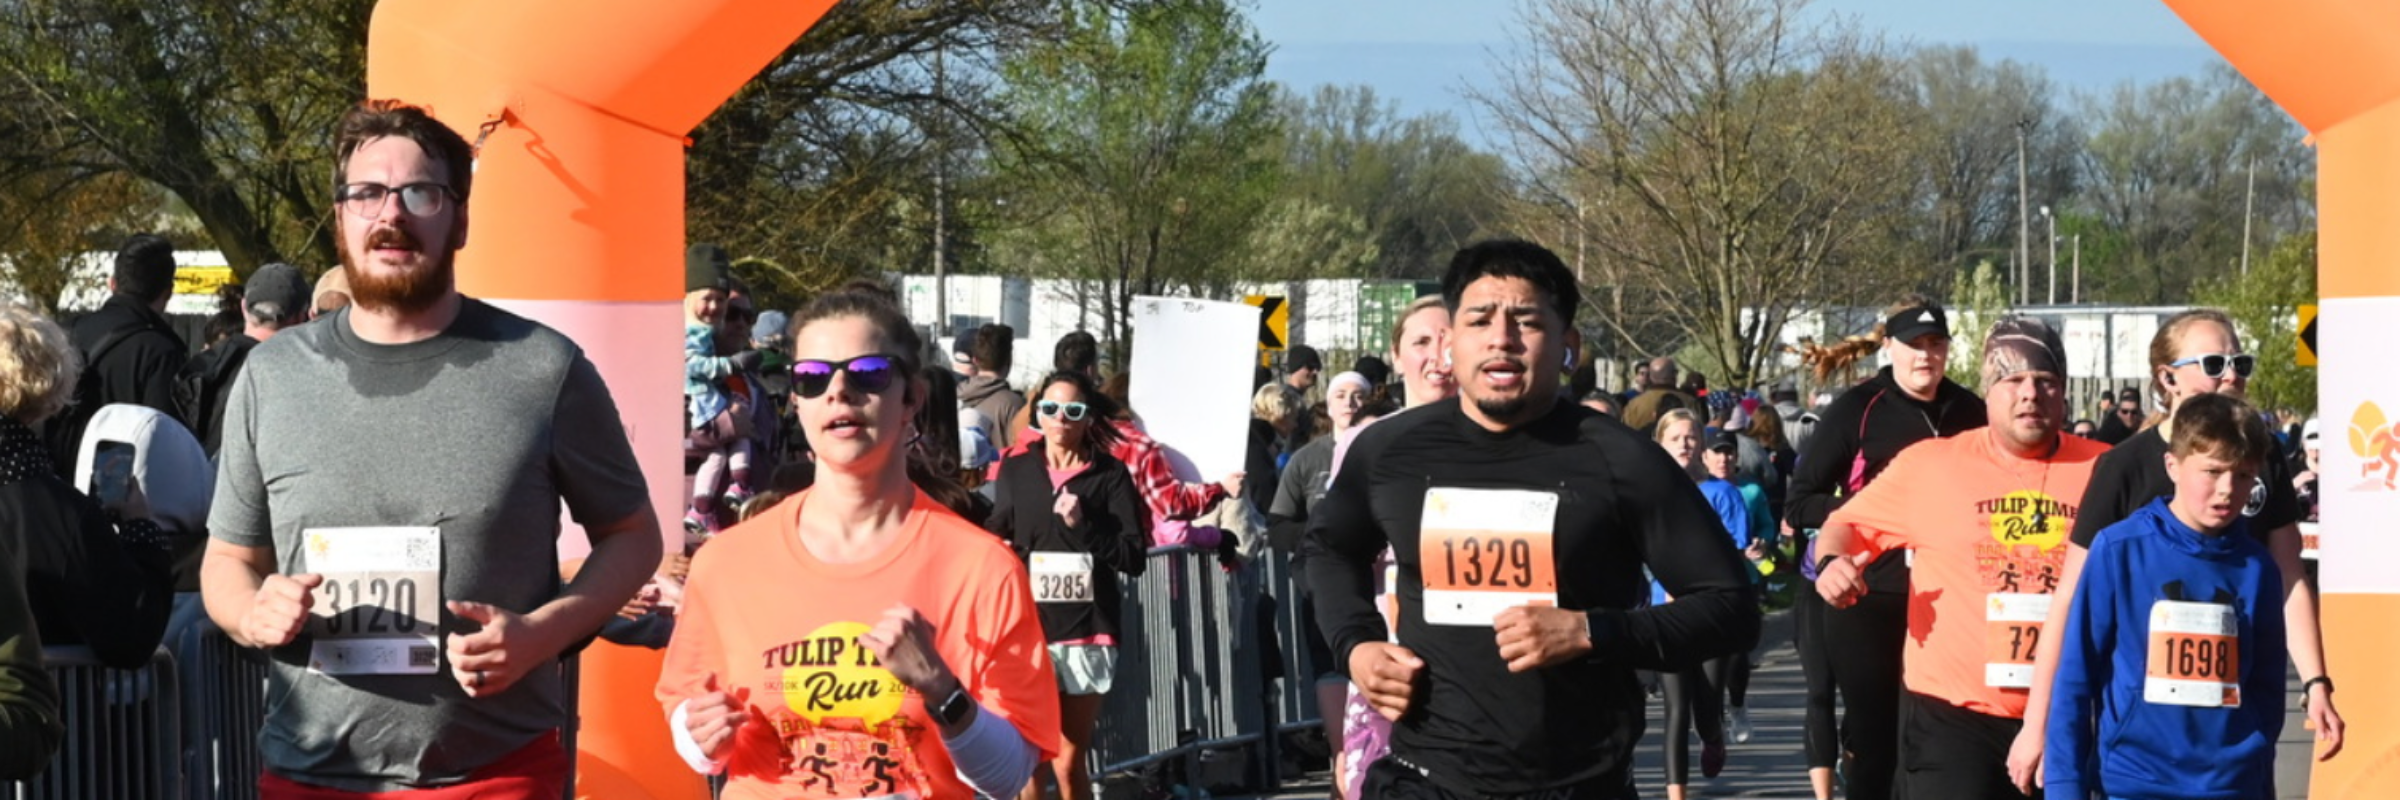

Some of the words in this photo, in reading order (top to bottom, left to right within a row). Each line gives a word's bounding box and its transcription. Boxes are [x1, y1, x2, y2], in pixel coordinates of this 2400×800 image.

[1974, 498, 2028, 514] TULIP
[1443, 536, 1532, 588] 1329
[1040, 574, 1085, 599] 3285
[325, 577, 416, 634] 3120
[763, 636, 844, 669] TULIP
[2009, 626, 2039, 661] 72
[2166, 638, 2228, 678] 1698
[804, 671, 882, 711] Run
